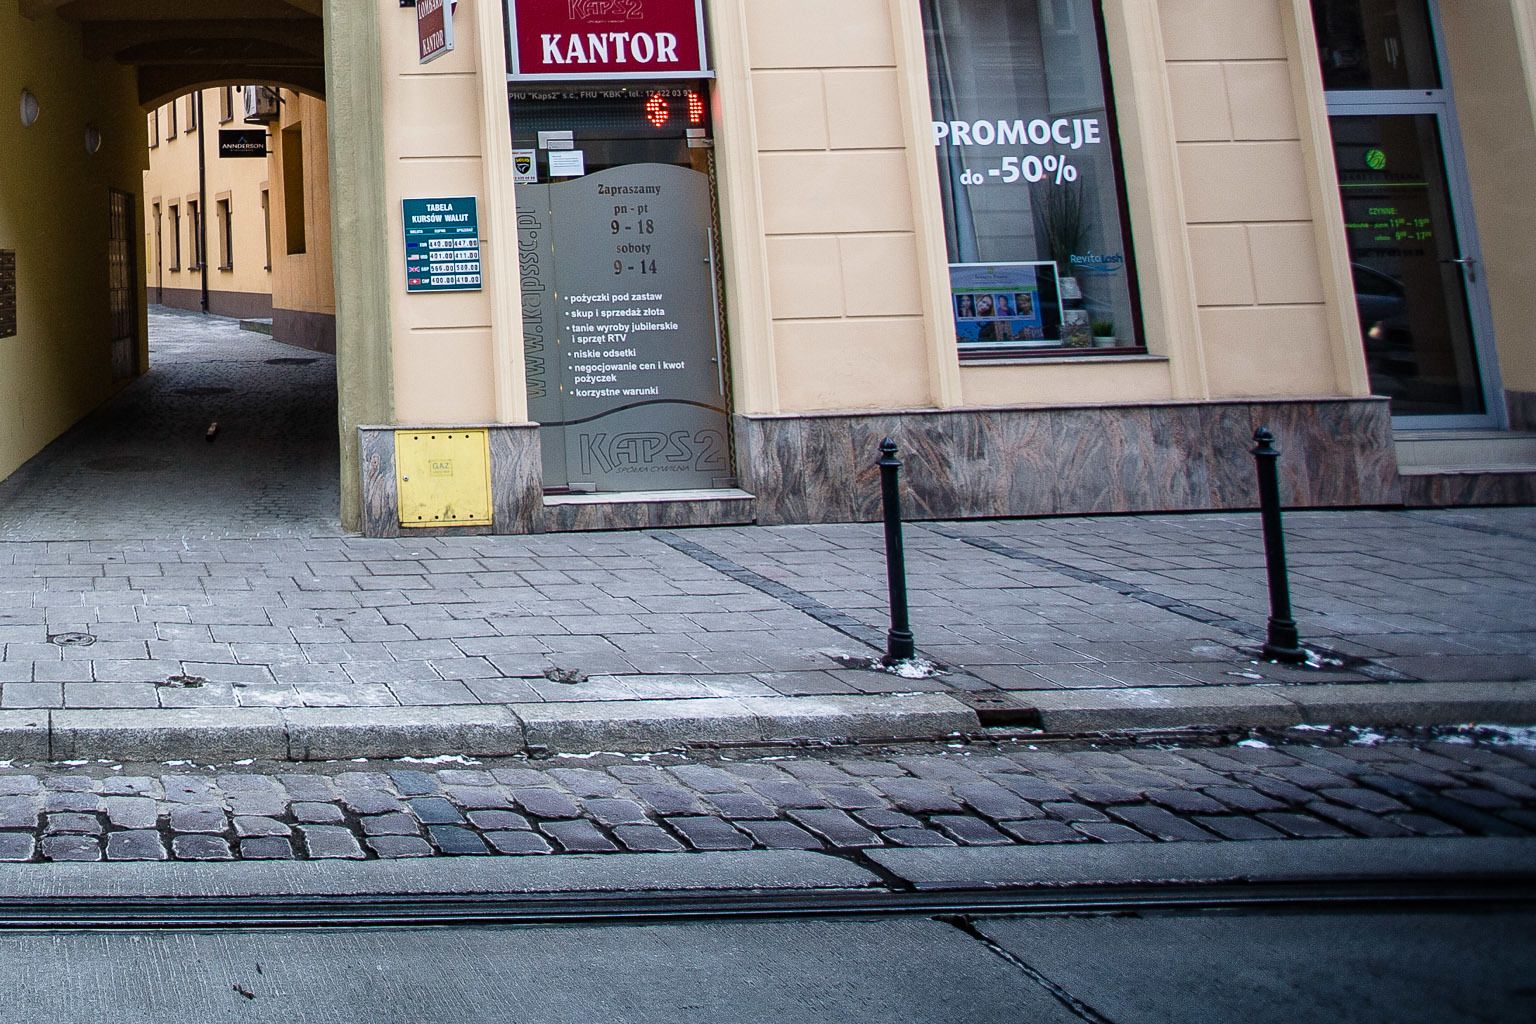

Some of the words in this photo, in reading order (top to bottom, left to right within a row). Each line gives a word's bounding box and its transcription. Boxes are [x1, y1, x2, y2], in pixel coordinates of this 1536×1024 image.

[422, 30, 444, 55] KANTOR
[540, 32, 679, 65] KANTOR
[932, 119, 1101, 149] PROMOCJE
[960, 169, 984, 185] do
[988, 155, 1077, 185] -50%
[598, 184, 661, 196] Zapraszamy
[426, 204, 453, 212] TABELA
[614, 205, 627, 216] pn
[637, 204, 648, 215] pt
[412, 213, 442, 223] KURSÓW
[444, 214, 469, 222] WALUT
[611, 220, 620, 235] 9
[638, 219, 654, 234] 18
[616, 243, 651, 255] soboty
[614, 259, 623, 275] 9
[640, 259, 657, 274] 14
[570, 293, 610, 304] pożyczki
[612, 293, 629, 303] pod
[631, 293, 662, 301] zastaw
[571, 309, 594, 319] skup
[601, 308, 641, 318] sprzedaż
[643, 308, 665, 316] złota
[572, 324, 595, 332] tanie
[596, 323, 630, 333] wyroby
[631, 322, 678, 332] jubilerskie
[577, 335, 606, 344] sprzęt
[608, 334, 627, 342] RTV
[574, 349, 601, 358] niskie
[603, 348, 636, 357] odsetki
[574, 362, 637, 373] negocjowanie
[663, 361, 685, 369] kwot
[574, 374, 617, 384] pożyczek
[576, 388, 620, 398] korzystne
[622, 386, 658, 395] warunki
[580, 429, 727, 475] KAPS2
